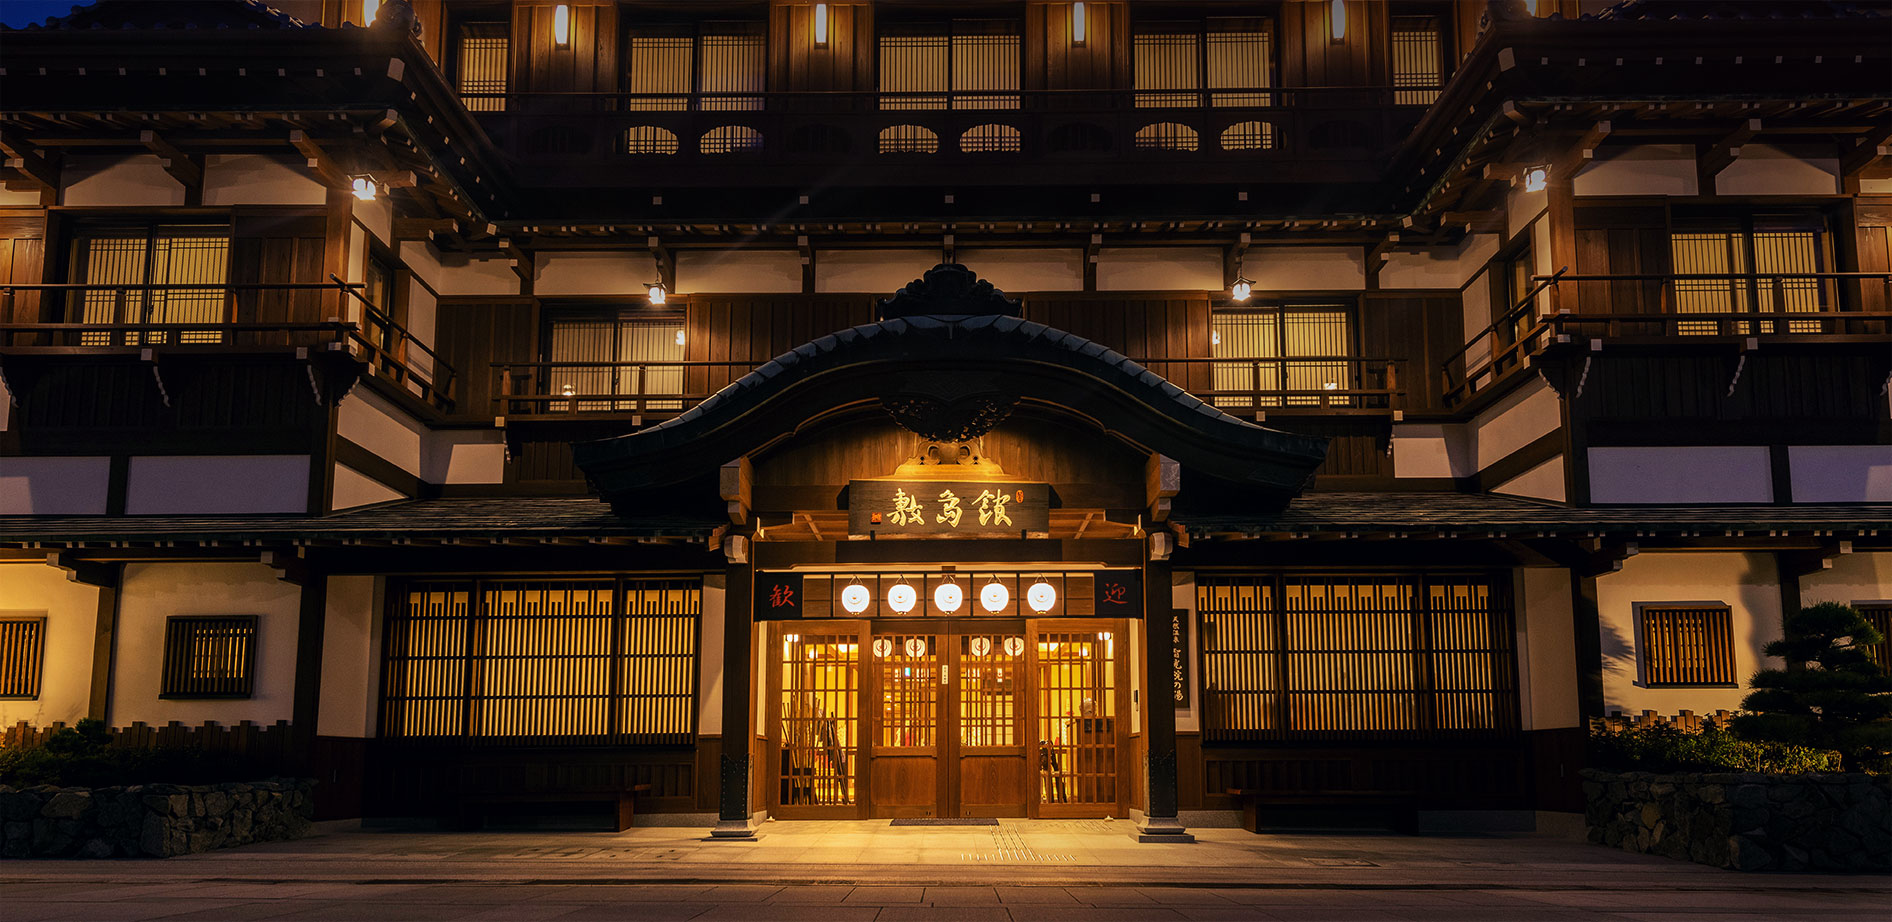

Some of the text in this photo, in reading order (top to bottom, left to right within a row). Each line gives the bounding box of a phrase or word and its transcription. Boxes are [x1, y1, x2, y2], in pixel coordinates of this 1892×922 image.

[886, 487, 1013, 528] 敷島館
[769, 584, 795, 608] 歓
[1103, 583, 1129, 605] 迎
